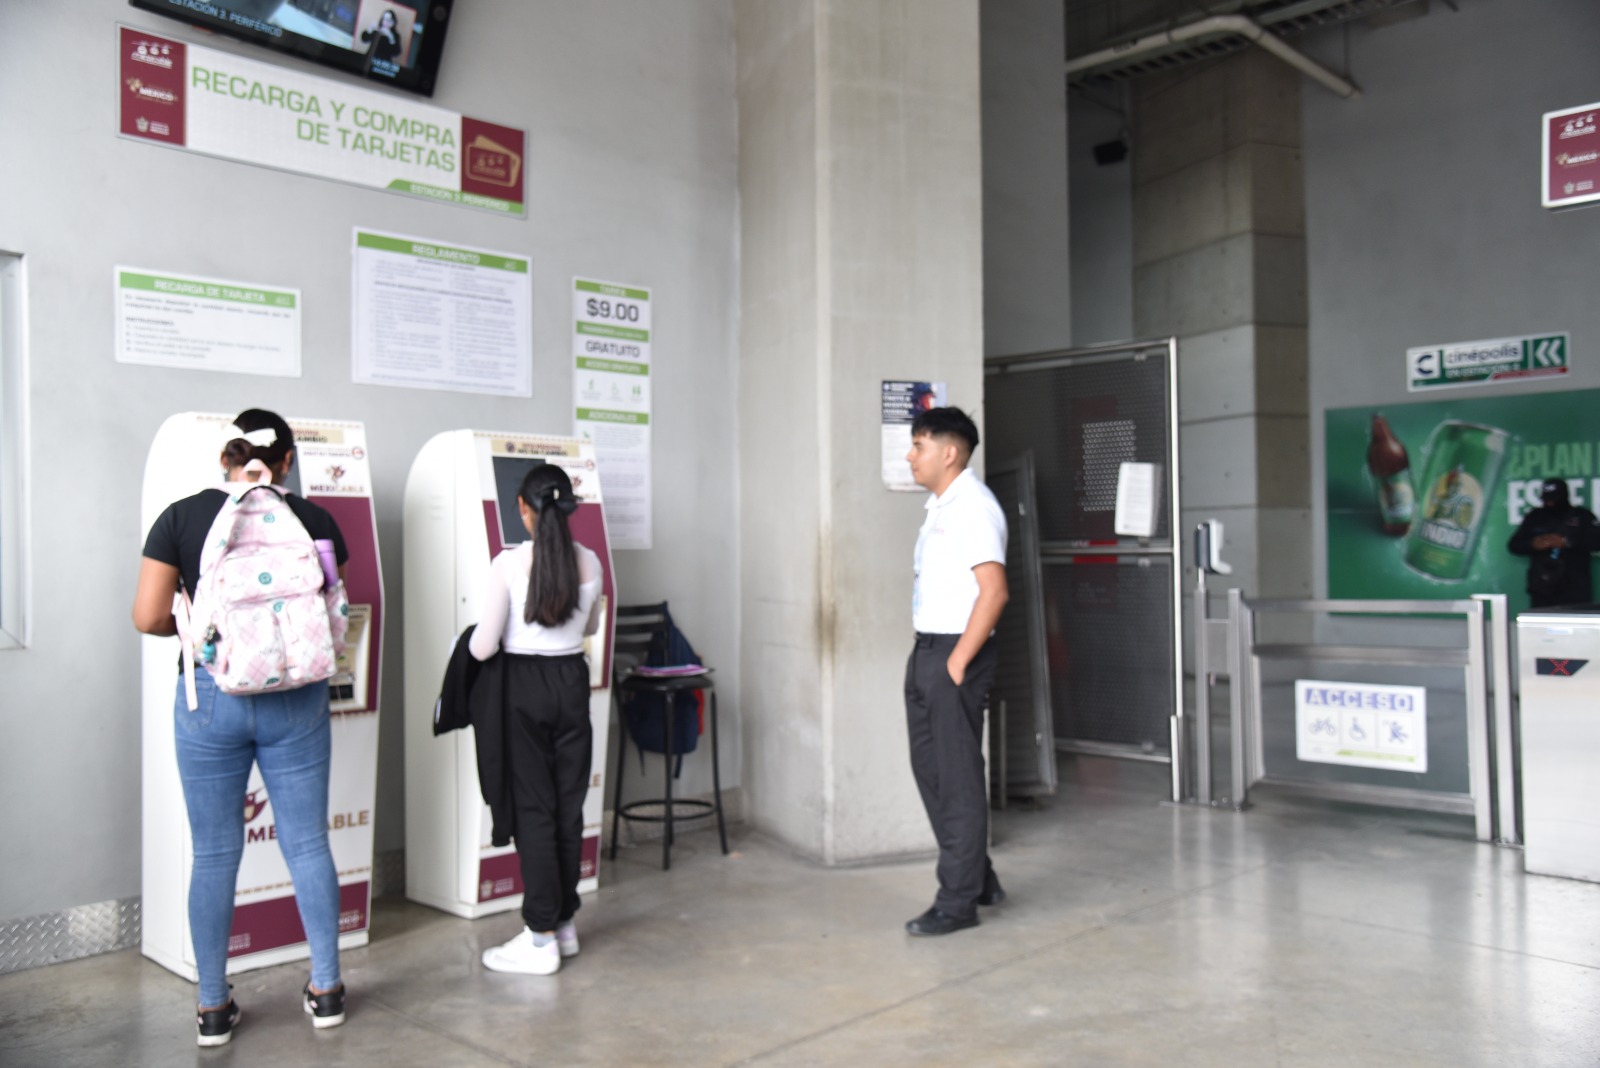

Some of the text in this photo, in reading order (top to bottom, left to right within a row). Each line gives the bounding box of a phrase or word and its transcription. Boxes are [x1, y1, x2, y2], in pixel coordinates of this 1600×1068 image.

[192, 66, 322, 118] RECARGA
[330, 100, 346, 122] Y
[353, 106, 456, 148] COMPRA
[297, 118, 330, 145] DE
[337, 127, 456, 173] TARJETAS
[412, 244, 480, 265] REGLAMENTO
[154, 279, 204, 296] RECARGA
[206, 285, 219, 298] DE
[222, 287, 266, 303] TARJETA
[586, 298, 639, 322] $9.00
[585, 339, 641, 359] GRATUITO
[1508, 442, 1592, 479] ¿PLAN
[1308, 688, 1412, 712] ACCESO
